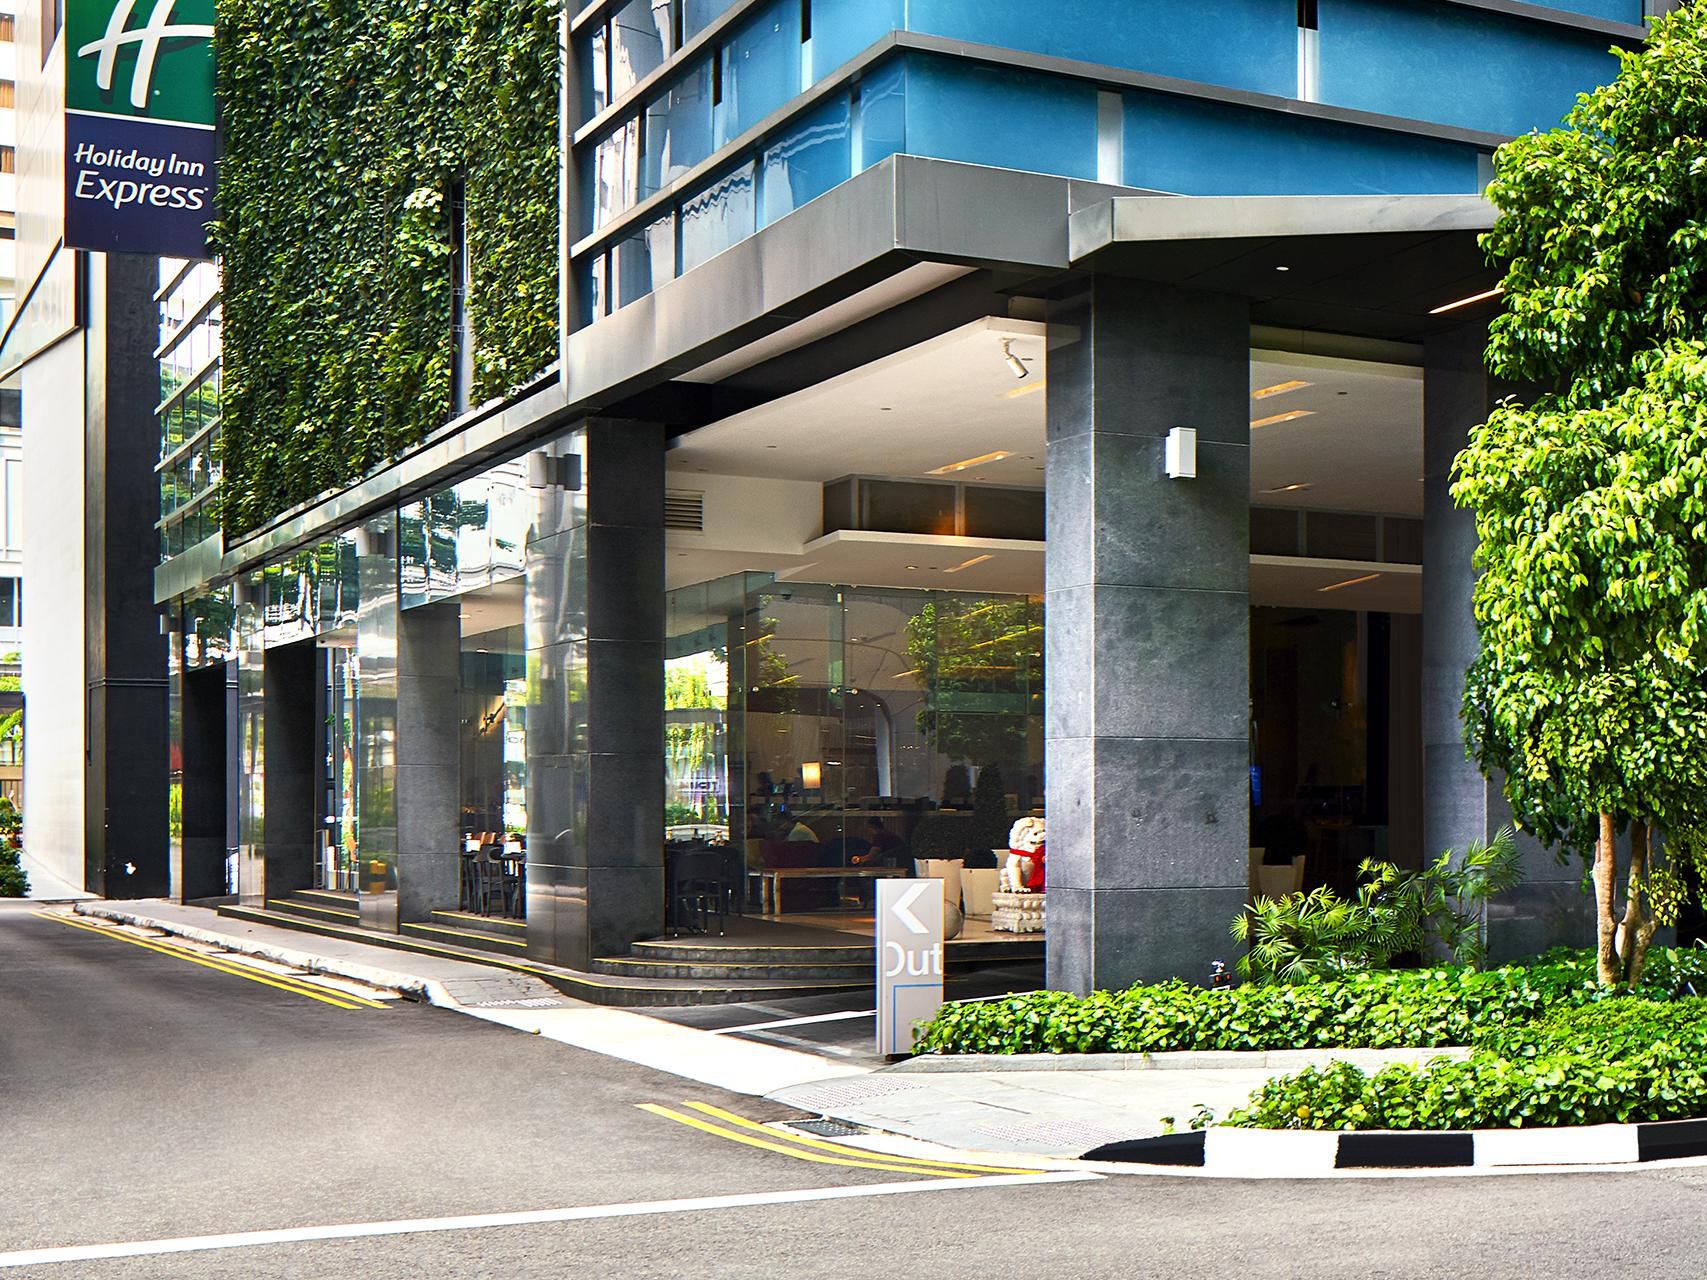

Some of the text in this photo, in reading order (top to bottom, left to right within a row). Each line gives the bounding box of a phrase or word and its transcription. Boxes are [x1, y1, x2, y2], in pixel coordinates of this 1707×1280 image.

[74, 143, 204, 176] Holiday Inn
[74, 170, 205, 210] Express
